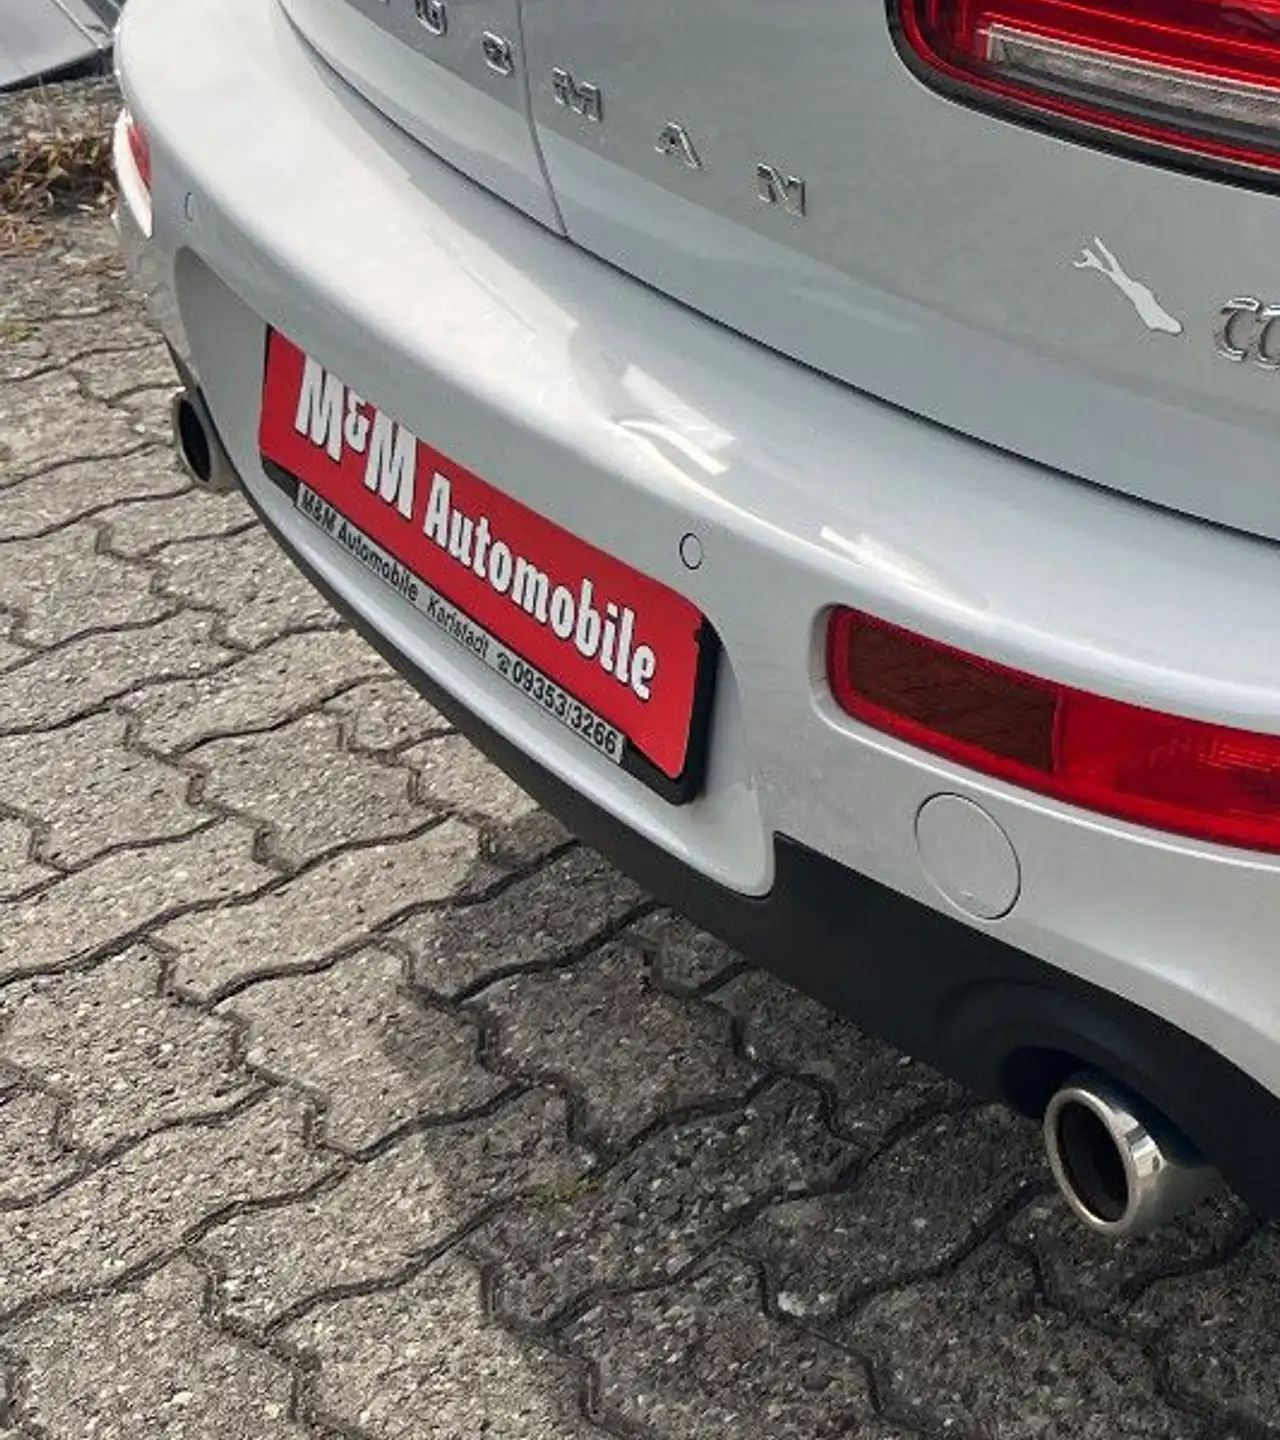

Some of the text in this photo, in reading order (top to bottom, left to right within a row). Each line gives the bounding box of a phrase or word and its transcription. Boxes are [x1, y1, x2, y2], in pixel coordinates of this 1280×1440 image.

[294, 355, 656, 702] M&M Automobile
[336, 520, 419, 604] Automobile
[426, 596, 490, 658] Karlstadt
[512, 663, 618, 755] 09353/3266
